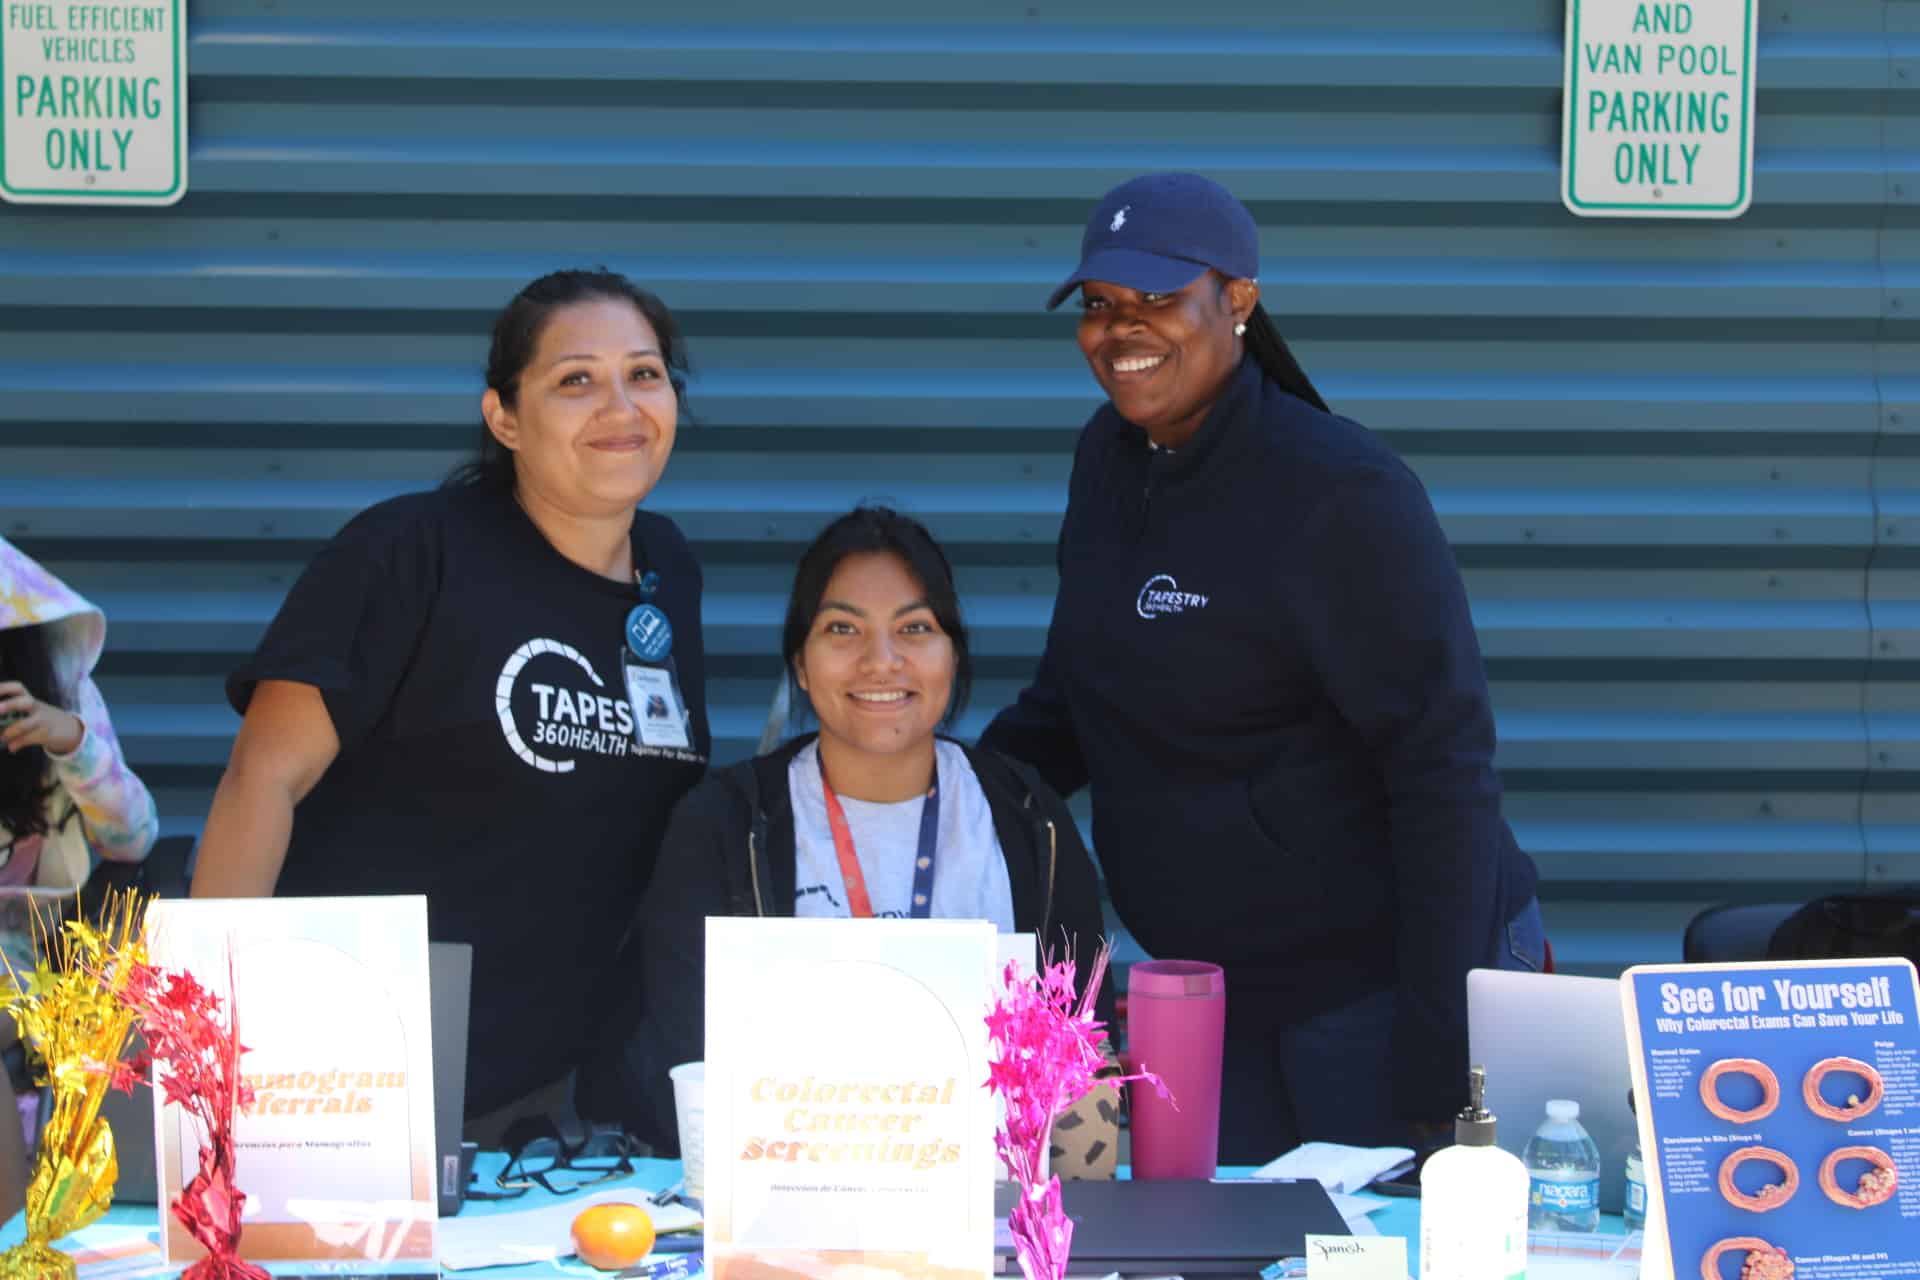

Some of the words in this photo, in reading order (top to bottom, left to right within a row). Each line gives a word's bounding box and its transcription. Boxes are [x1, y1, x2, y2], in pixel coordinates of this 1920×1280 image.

[10, 5, 58, 30] FUEL
[68, 6, 164, 32] EFFICIENT
[1633, 4, 1692, 33] AND
[43, 37, 135, 62] VEHICLES
[1586, 43, 1641, 73] VAN
[1658, 45, 1736, 75] POOL
[17, 75, 161, 118] PARKING
[1589, 91, 1729, 133] PARKING
[46, 128, 133, 171] ONLY
[1615, 143, 1701, 184] ONLY
[1148, 590, 1208, 608] TAPESTRY
[531, 684, 634, 734] TAPES
[533, 721, 627, 756] 360HEALTH
[1661, 982, 1715, 1014] See
[1722, 981, 1766, 1012] for
[1773, 976, 1891, 1010] Yourself
[1656, 1018, 1683, 1034] Why
[1686, 1016, 1749, 1031] Colorectal
[1752, 1015, 1791, 1029] Exams
[1793, 1014, 1816, 1028] Can
[1818, 1013, 1848, 1027] Save
[1850, 1011, 1878, 1025] Your
[1881, 1010, 1904, 1024] Life
[242, 1071, 405, 1094] mmogram
[751, 1075, 957, 1104] Colorectal
[254, 1092, 372, 1115] ferrals
[784, 1107, 922, 1132] Cancer
[739, 1136, 960, 1171] Screenings
